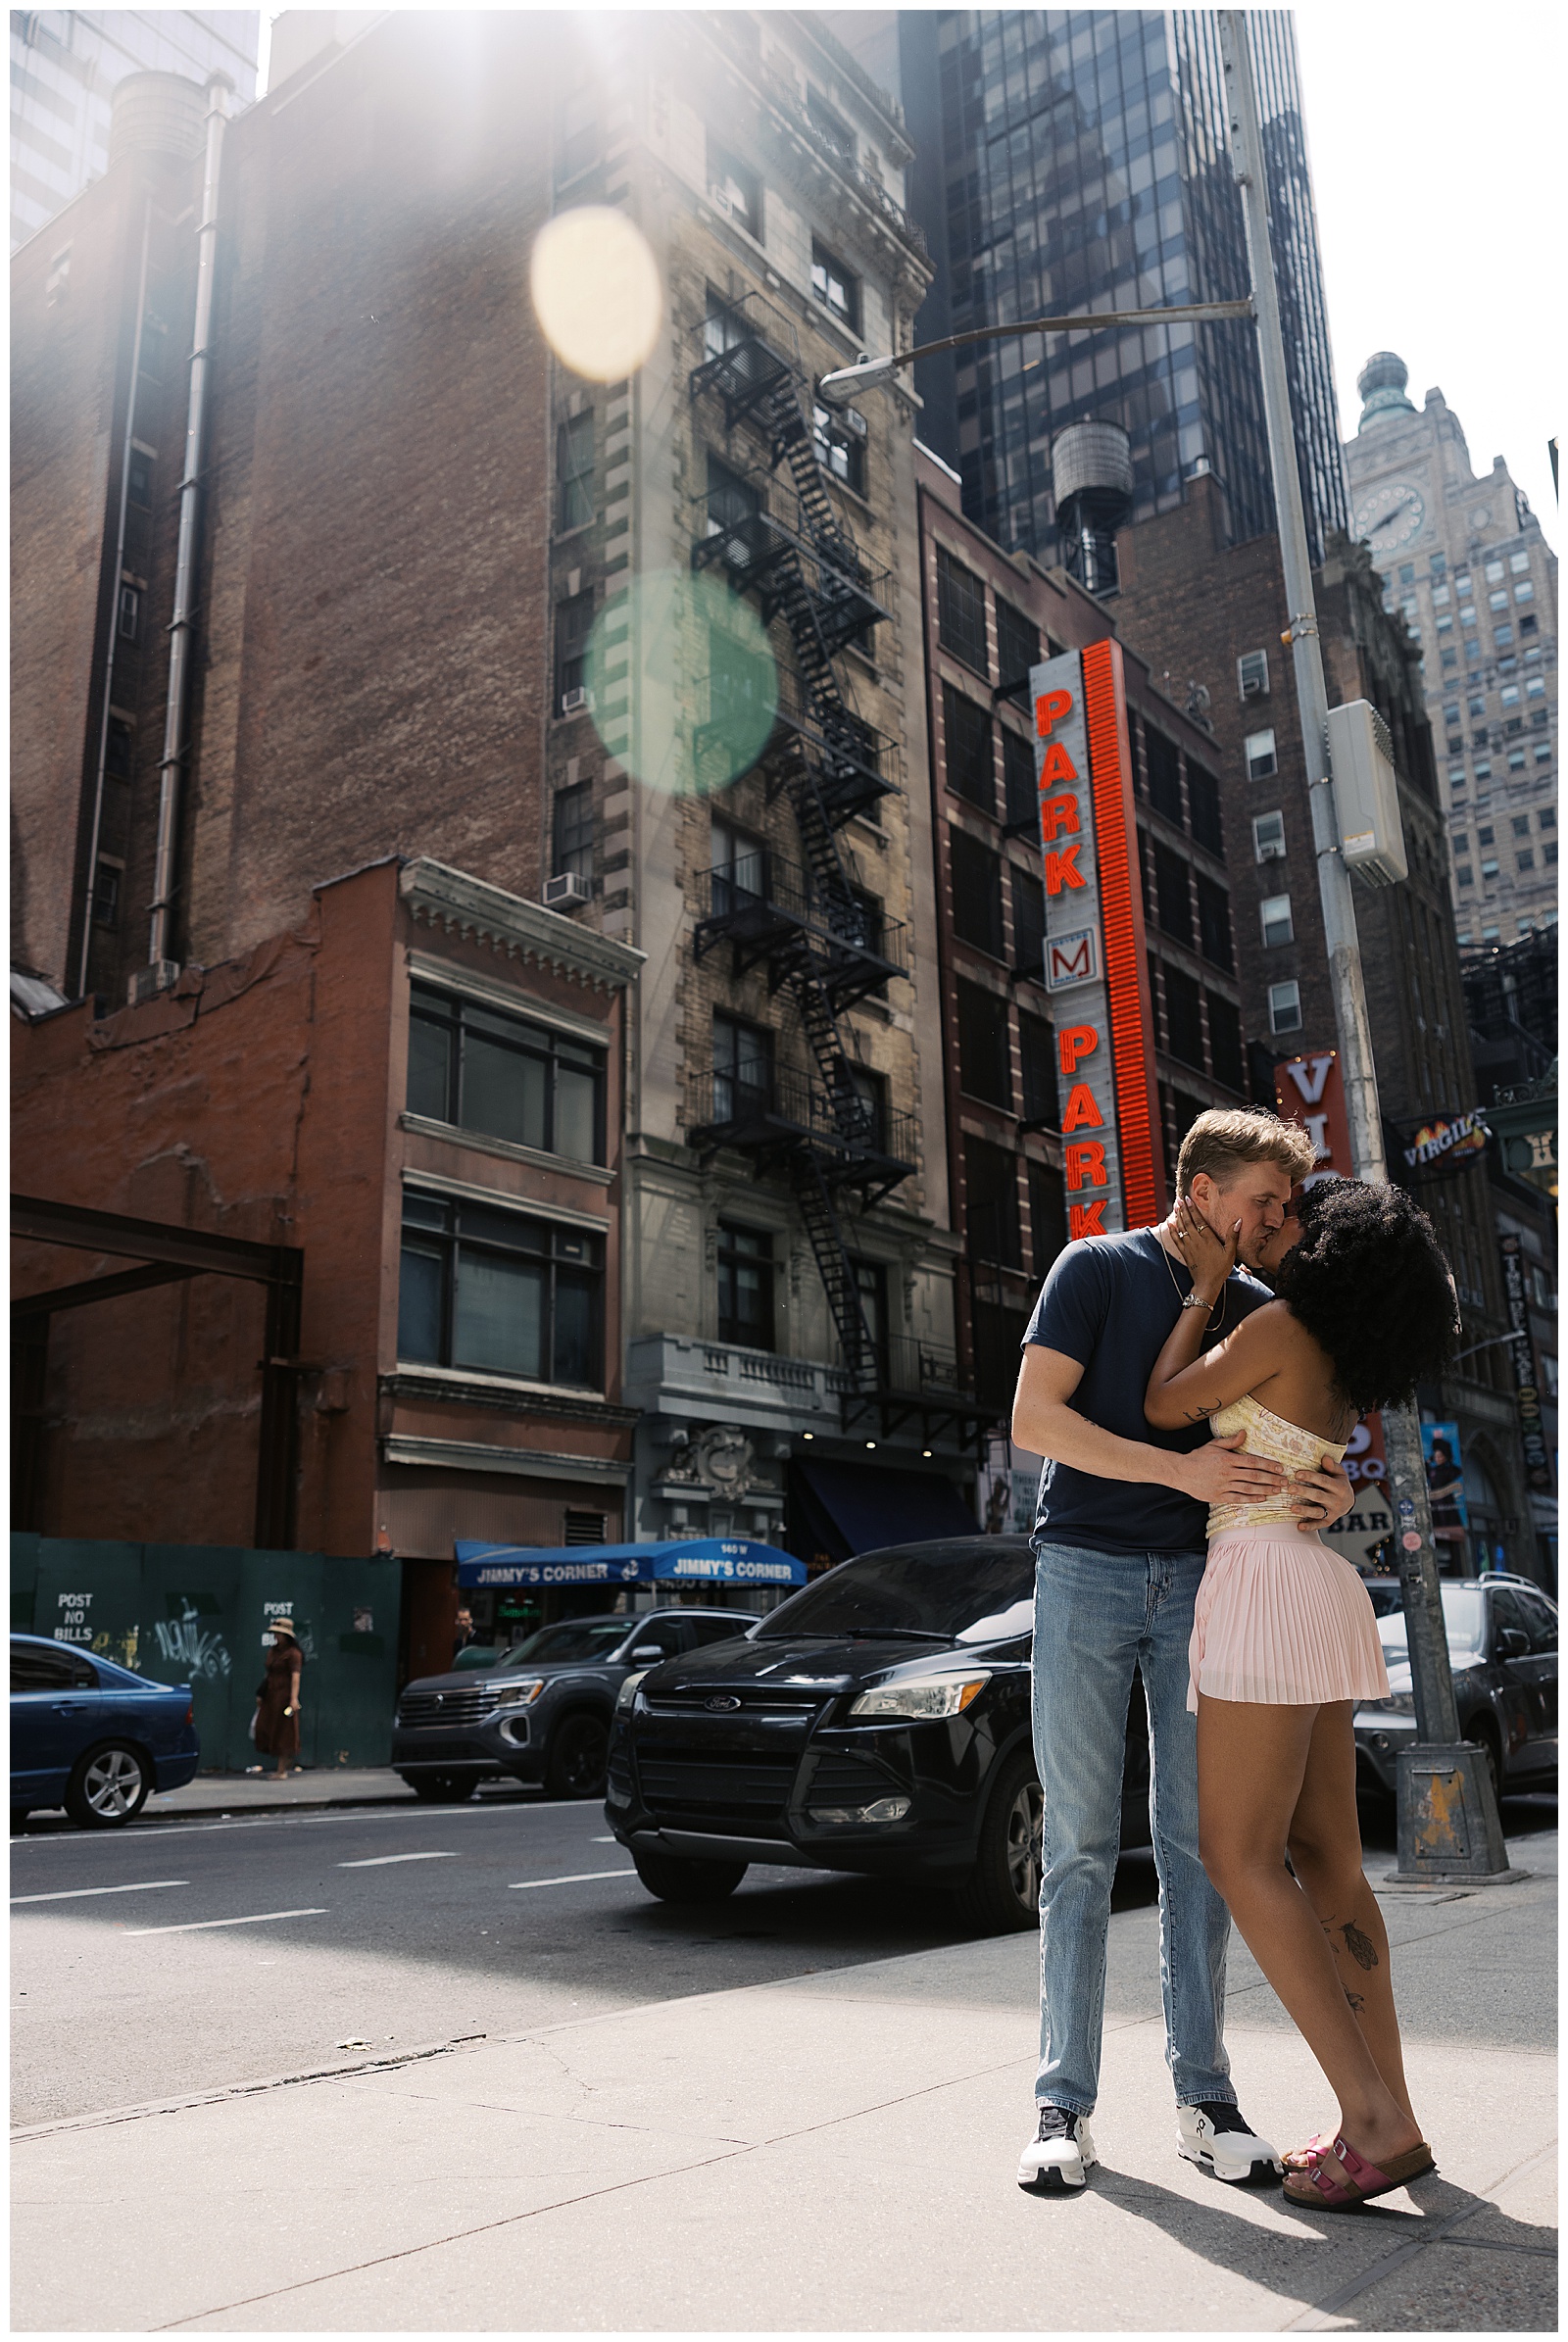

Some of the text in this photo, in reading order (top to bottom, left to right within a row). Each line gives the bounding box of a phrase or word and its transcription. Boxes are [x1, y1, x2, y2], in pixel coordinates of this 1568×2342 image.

[1036, 689, 1087, 896] PARK
[1058, 1025, 1108, 1242] PARK
[1341, 1457, 1387, 1482] BQ
[1327, 1511, 1391, 1535] BAR
[739, 1544, 749, 1556] W
[476, 1563, 609, 1586] JIMMY'S CORNER
[673, 1558, 734, 1577] JIMMY'S
[736, 1561, 792, 1581] CORNER
[58, 1593, 93, 1607] POST
[264, 1601, 294, 1616] POST
[64, 1610, 84, 1625] NO
[54, 1627, 93, 1641] BILLS
[710, 1696, 732, 1708] Ford
